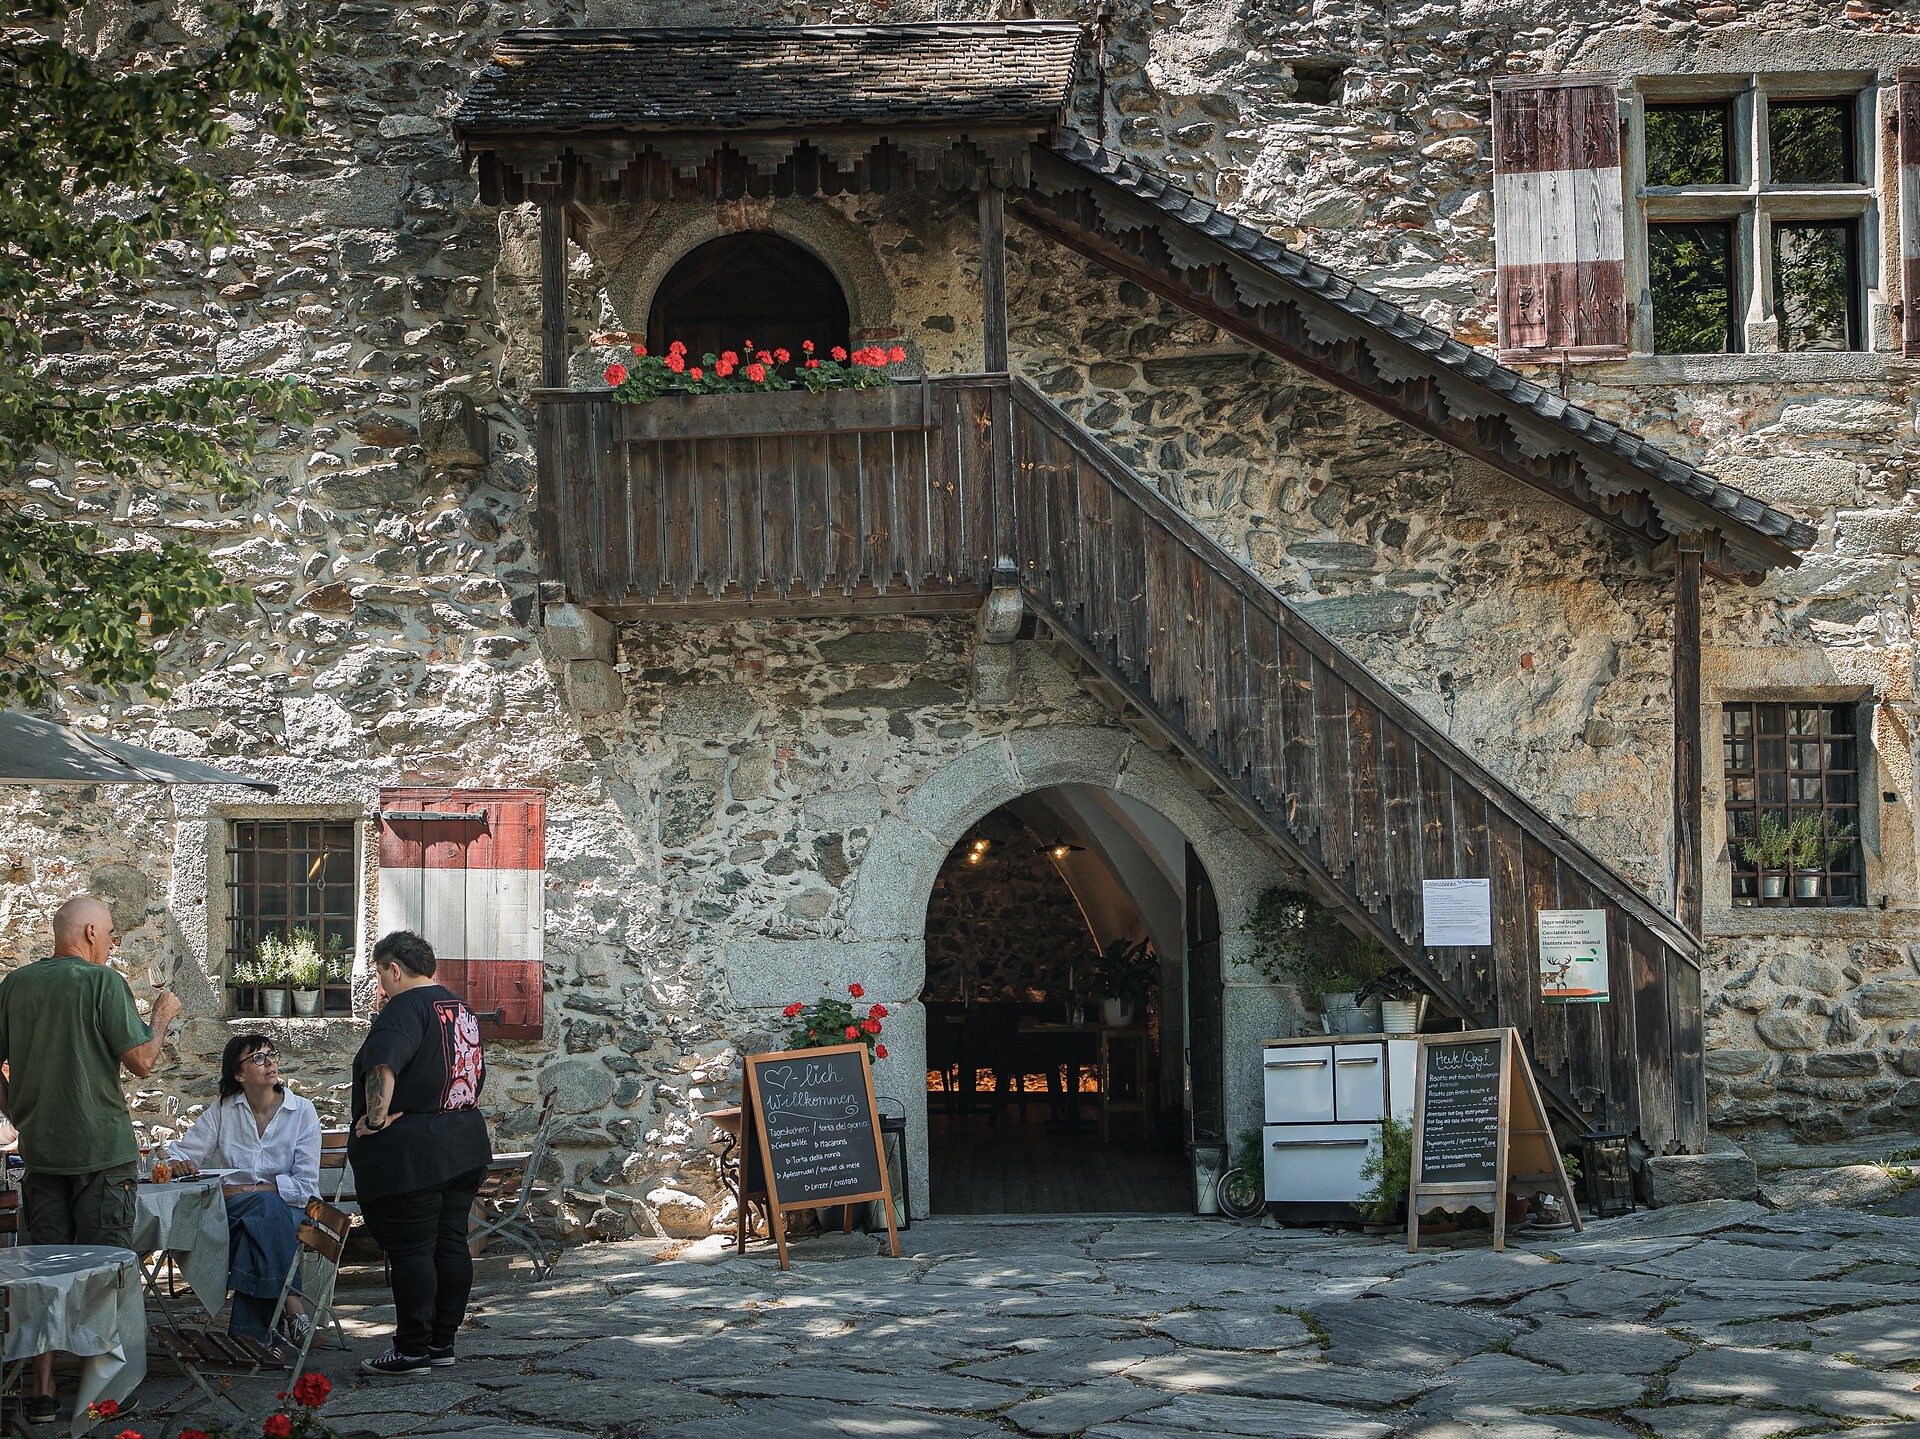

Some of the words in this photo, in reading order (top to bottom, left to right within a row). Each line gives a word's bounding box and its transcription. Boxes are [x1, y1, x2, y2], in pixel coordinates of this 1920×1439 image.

[1429, 1074, 1448, 1082] Risotto
[766, 1091, 859, 1110] Willkommen
[769, 1126, 810, 1140] Tageskuchen:
[836, 1122, 846, 1130] del
[820, 1138, 848, 1148] Macarons
[792, 1156, 808, 1164] Torta
[808, 1154, 824, 1162] della
[824, 1151, 841, 1160] nonna
[810, 1182, 830, 1192] Linzer
